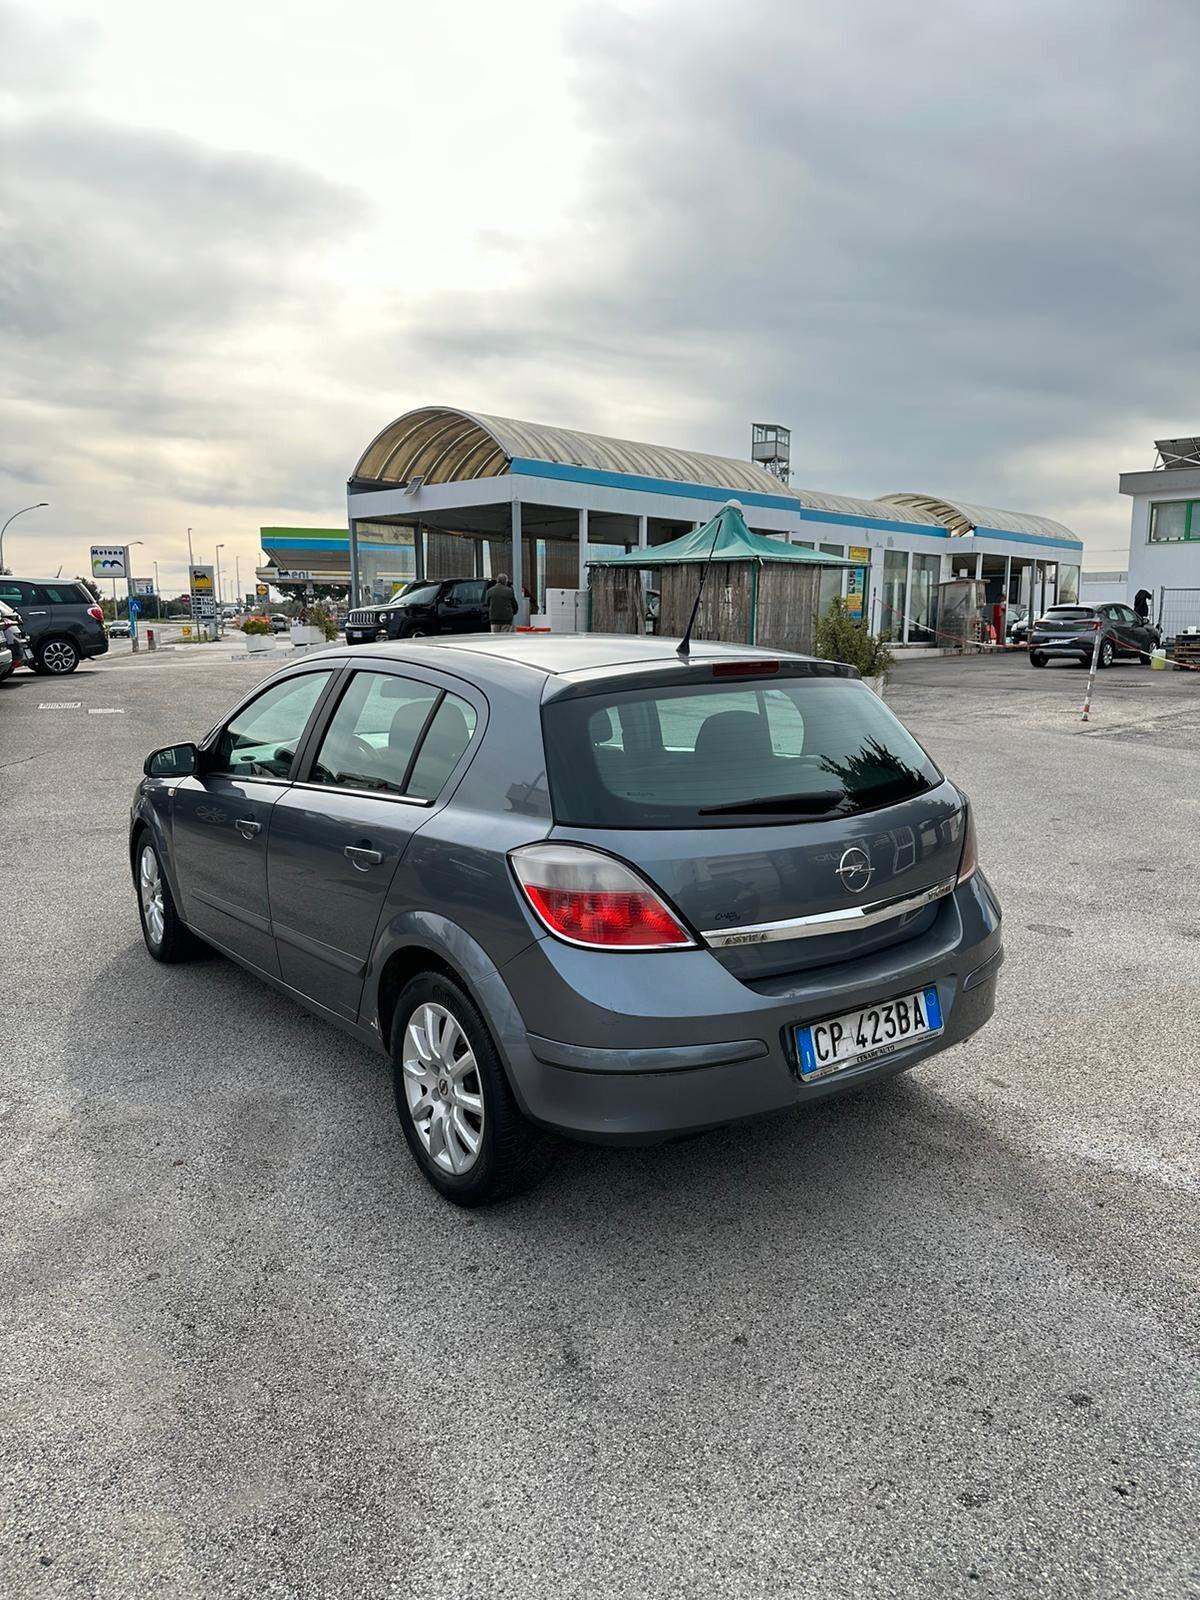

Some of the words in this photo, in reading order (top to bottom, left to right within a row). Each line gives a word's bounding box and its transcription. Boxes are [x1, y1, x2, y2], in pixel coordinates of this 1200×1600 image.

[291, 570, 309, 579] eni
[814, 1021, 843, 1061] CP
[856, 996, 926, 1048] 423BA
